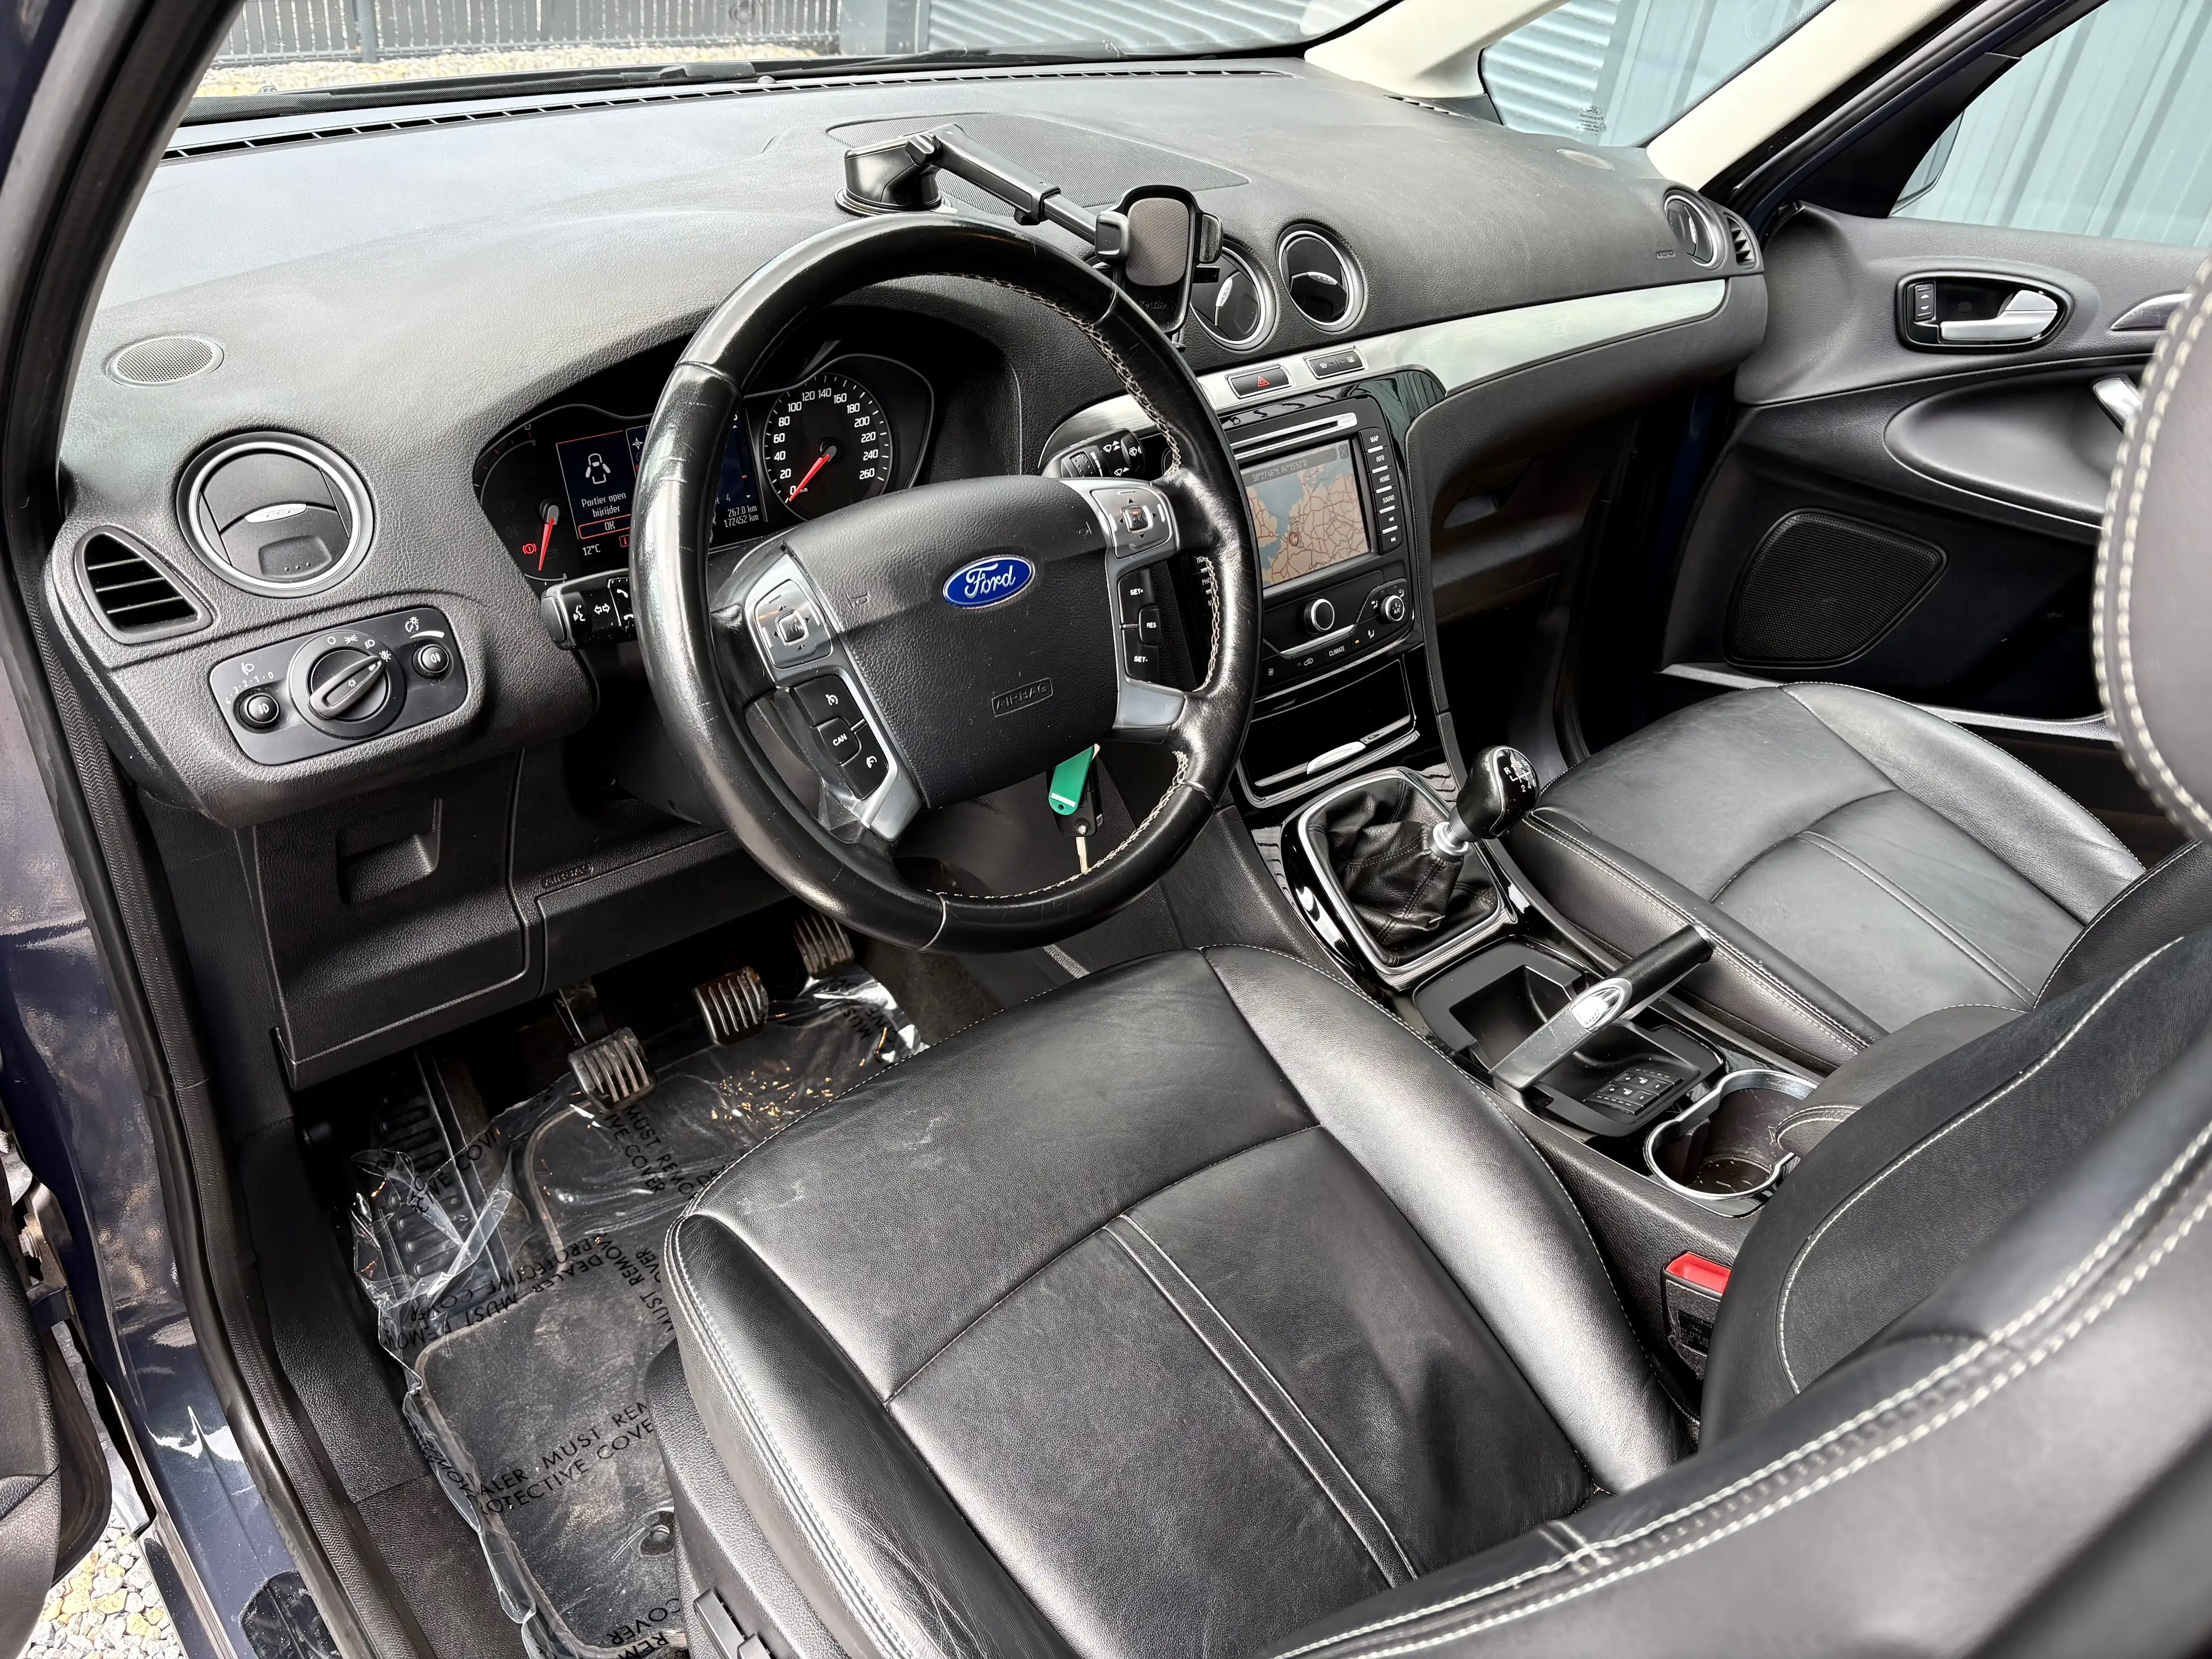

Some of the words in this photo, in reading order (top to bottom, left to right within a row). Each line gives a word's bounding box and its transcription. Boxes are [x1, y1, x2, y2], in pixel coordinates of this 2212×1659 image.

[802, 391, 815, 402] 120
[818, 388, 831, 399] 140
[834, 393, 847, 404] 160
[787, 402, 802, 412] 100
[847, 403, 860, 414] 180
[778, 416, 790, 427] 80
[854, 416, 870, 428] 200
[773, 433, 785, 444] 60
[861, 431, 876, 443] 220
[1370, 435, 1379, 443] MAP
[774, 450, 786, 461] 40
[863, 449, 878, 461] 240
[1376, 454, 1385, 463] INFO
[780, 468, 791, 479] 20
[859, 468, 874, 480] 260
[1379, 474, 1390, 483] HOME
[581, 496, 606, 507] Portier
[608, 493, 627, 502] open
[1382, 495, 1395, 503] SOUND
[592, 505, 620, 517] bijrijder
[728, 506, 745, 517] 267.0
[748, 505, 757, 513] km
[604, 520, 616, 531] OK
[724, 514, 748, 528] 172452
[749, 514, 759, 522] km
[582, 544, 601, 556] 12°C
[964, 563, 1016, 599] Ford
[1328, 645, 1346, 657] CLIMATE
[997, 683, 1048, 710] AIRBAG
[832, 733, 848, 747] CAN
[1503, 767, 1512, 775] R
[1521, 784, 1527, 793] 2
[624, 1104, 661, 1147] MUST
[656, 1154, 696, 1200] REMO
[625, 1144, 666, 1192] COVER
[532, 1254, 604, 1292] DEALER
[465, 1293, 517, 1326] MUST
[542, 1426, 600, 1469] MUST
[607, 1598, 681, 1645] COVER
